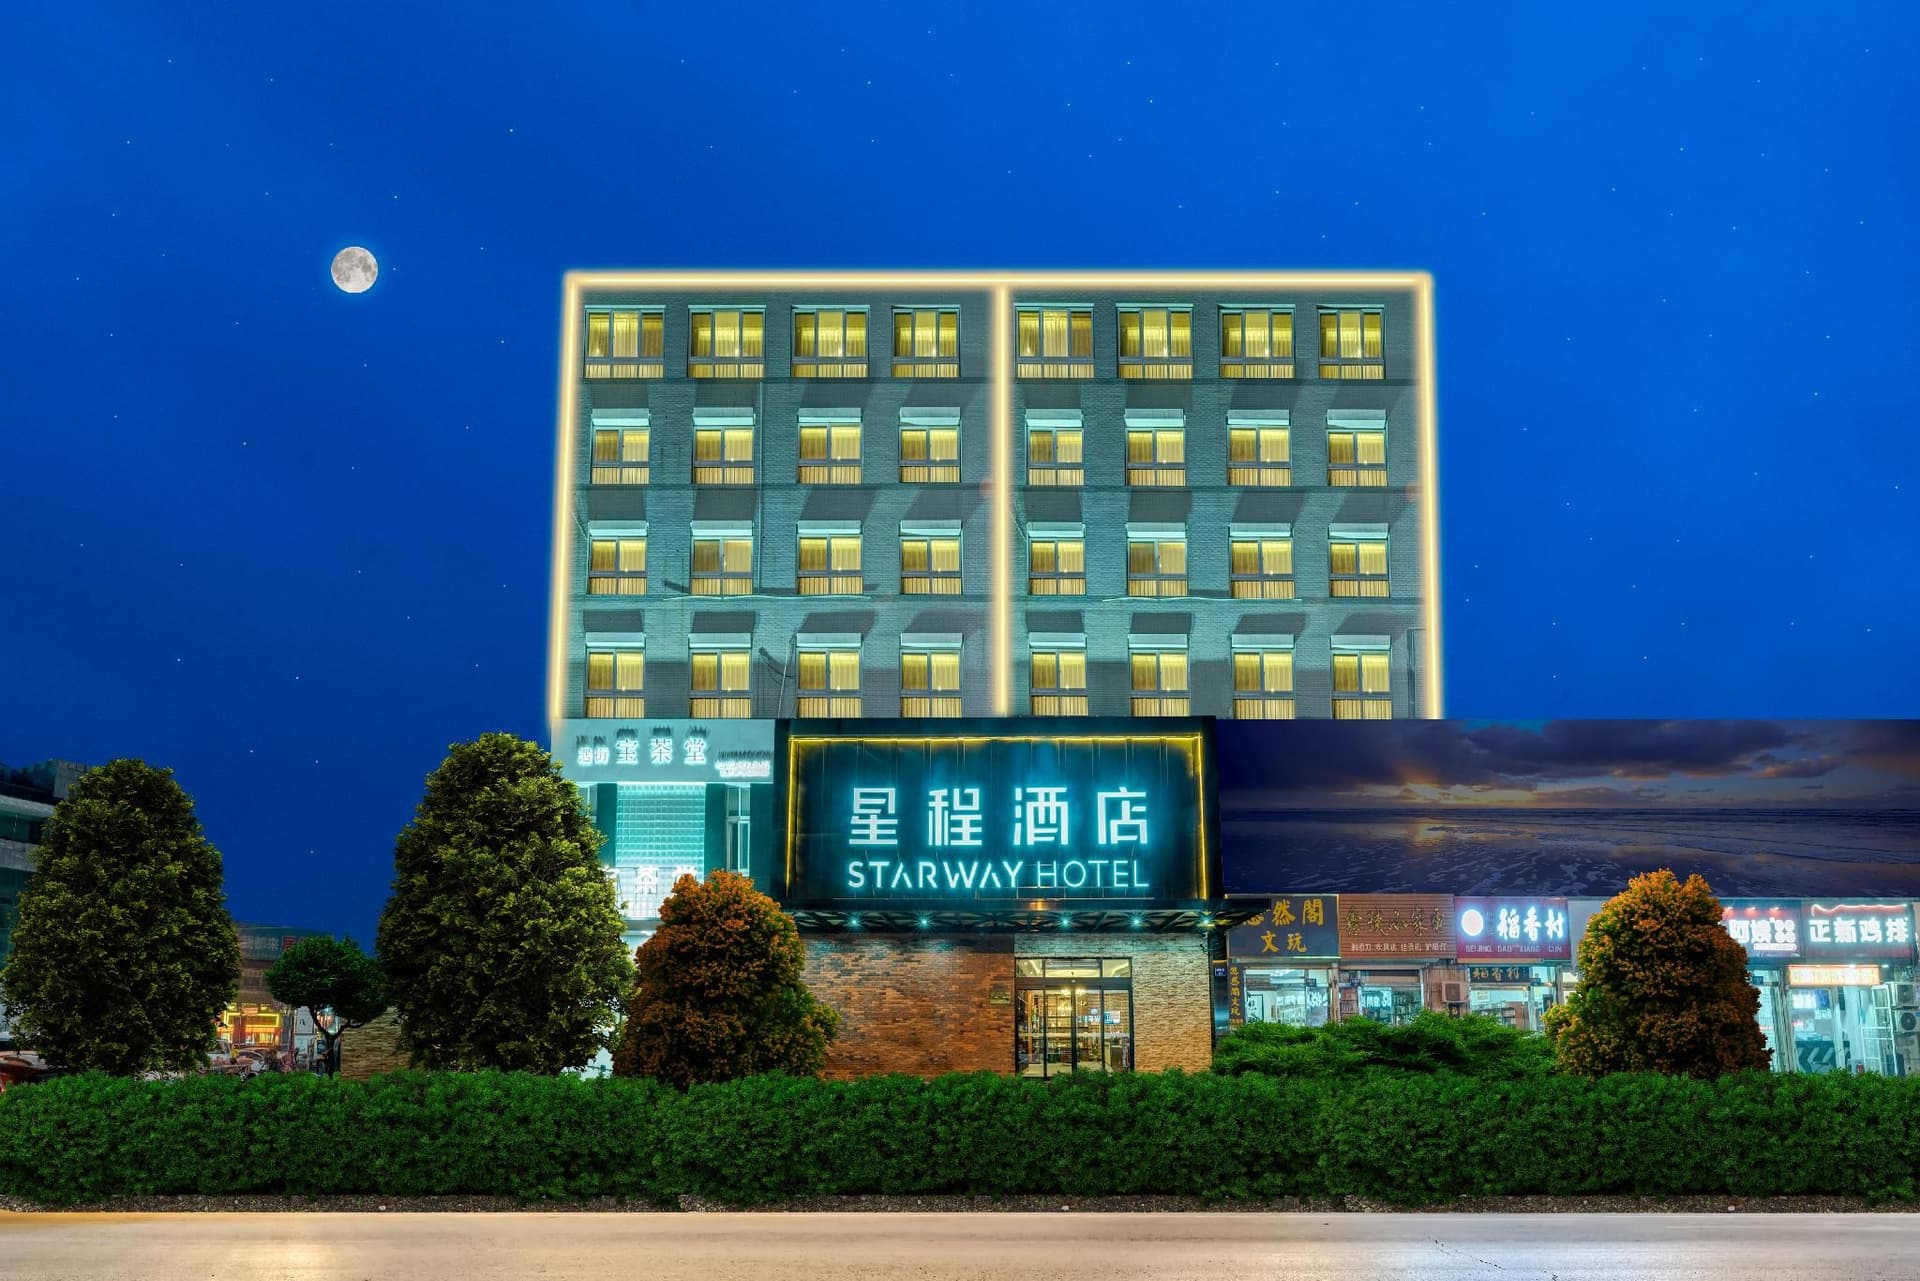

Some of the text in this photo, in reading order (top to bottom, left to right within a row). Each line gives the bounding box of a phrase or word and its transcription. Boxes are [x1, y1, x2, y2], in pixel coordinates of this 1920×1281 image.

[848, 786, 1149, 846] 星程酒店
[848, 860, 1150, 889] STARWAY HOTEL
[1497, 906, 1564, 941] 稻香村
[1808, 916, 1909, 943] 正新鸡排
[1260, 930, 1308, 953] 文玩
